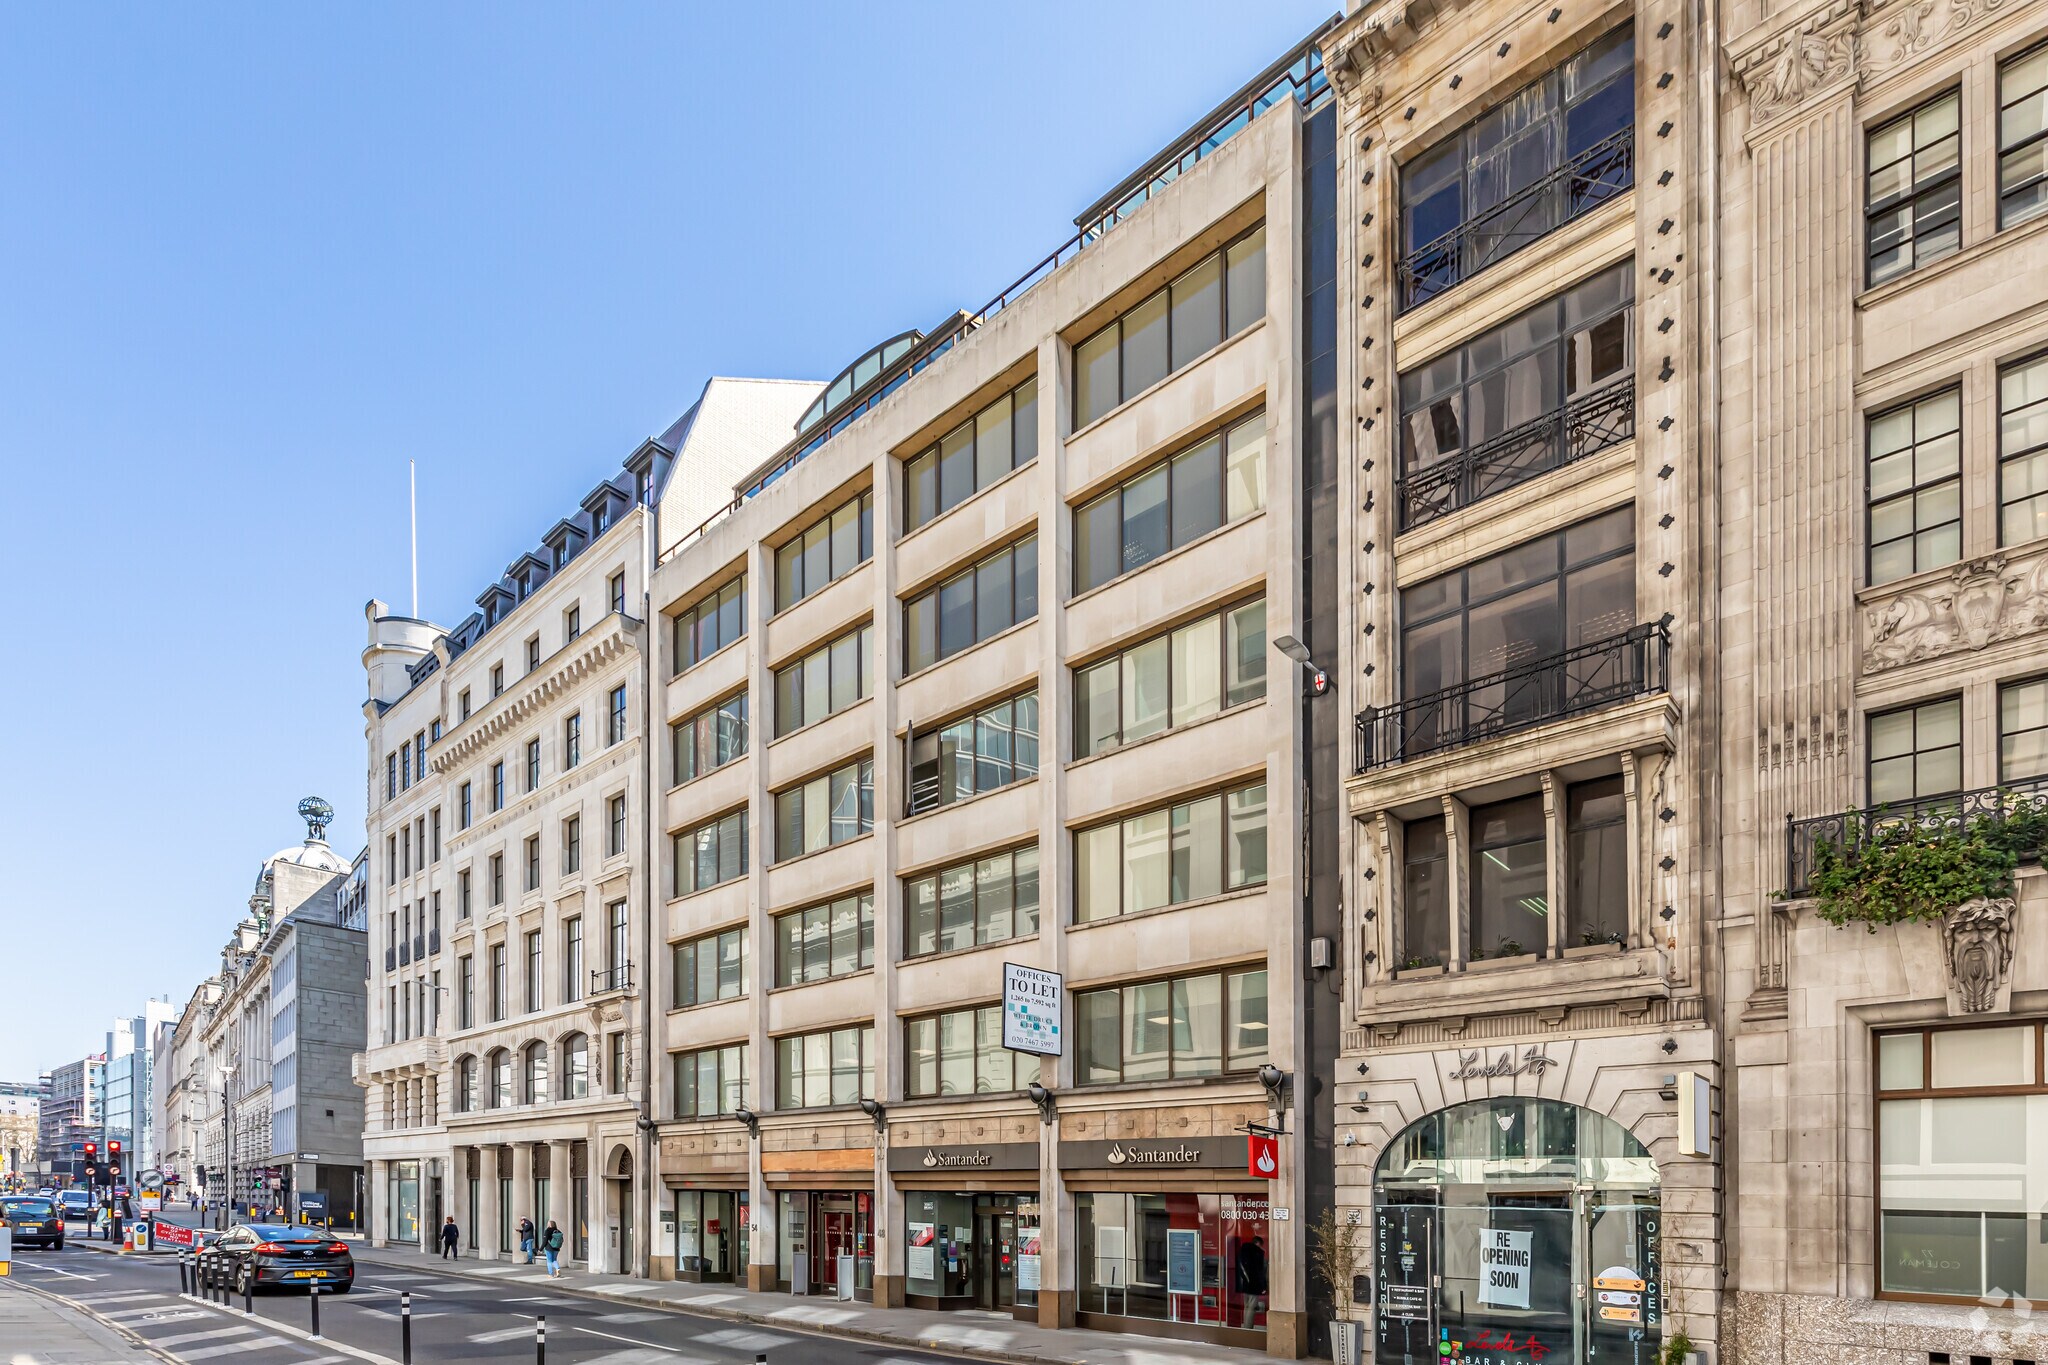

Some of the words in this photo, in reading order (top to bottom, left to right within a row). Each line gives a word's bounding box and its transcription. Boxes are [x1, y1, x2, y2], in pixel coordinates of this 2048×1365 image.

[1016, 969, 1052, 983] OFFICES
[1009, 978, 1028, 993] TO
[1032, 982, 1058, 999] LET
[1011, 1035, 1024, 1043] 020
[1024, 1037, 1039, 1046] 7467
[1040, 1040, 1055, 1048] 5997
[1449, 1049, 1513, 1080] Levels
[938, 1150, 991, 1167] Santander
[1128, 1144, 1200, 1163] Santander
[1221, 1210, 1241, 1220] 0800
[1242, 1210, 1258, 1220] 030
[751, 1223, 758, 1232] 54
[1496, 1232, 1511, 1248] RE
[1482, 1247, 1529, 1267] OPENING
[1379, 1216, 1388, 1344] RESTAURANT
[1490, 1270, 1519, 1289] SOON
[1646, 1221, 1656, 1324] OFFICES
[1465, 1355, 1490, 1365] BAR
